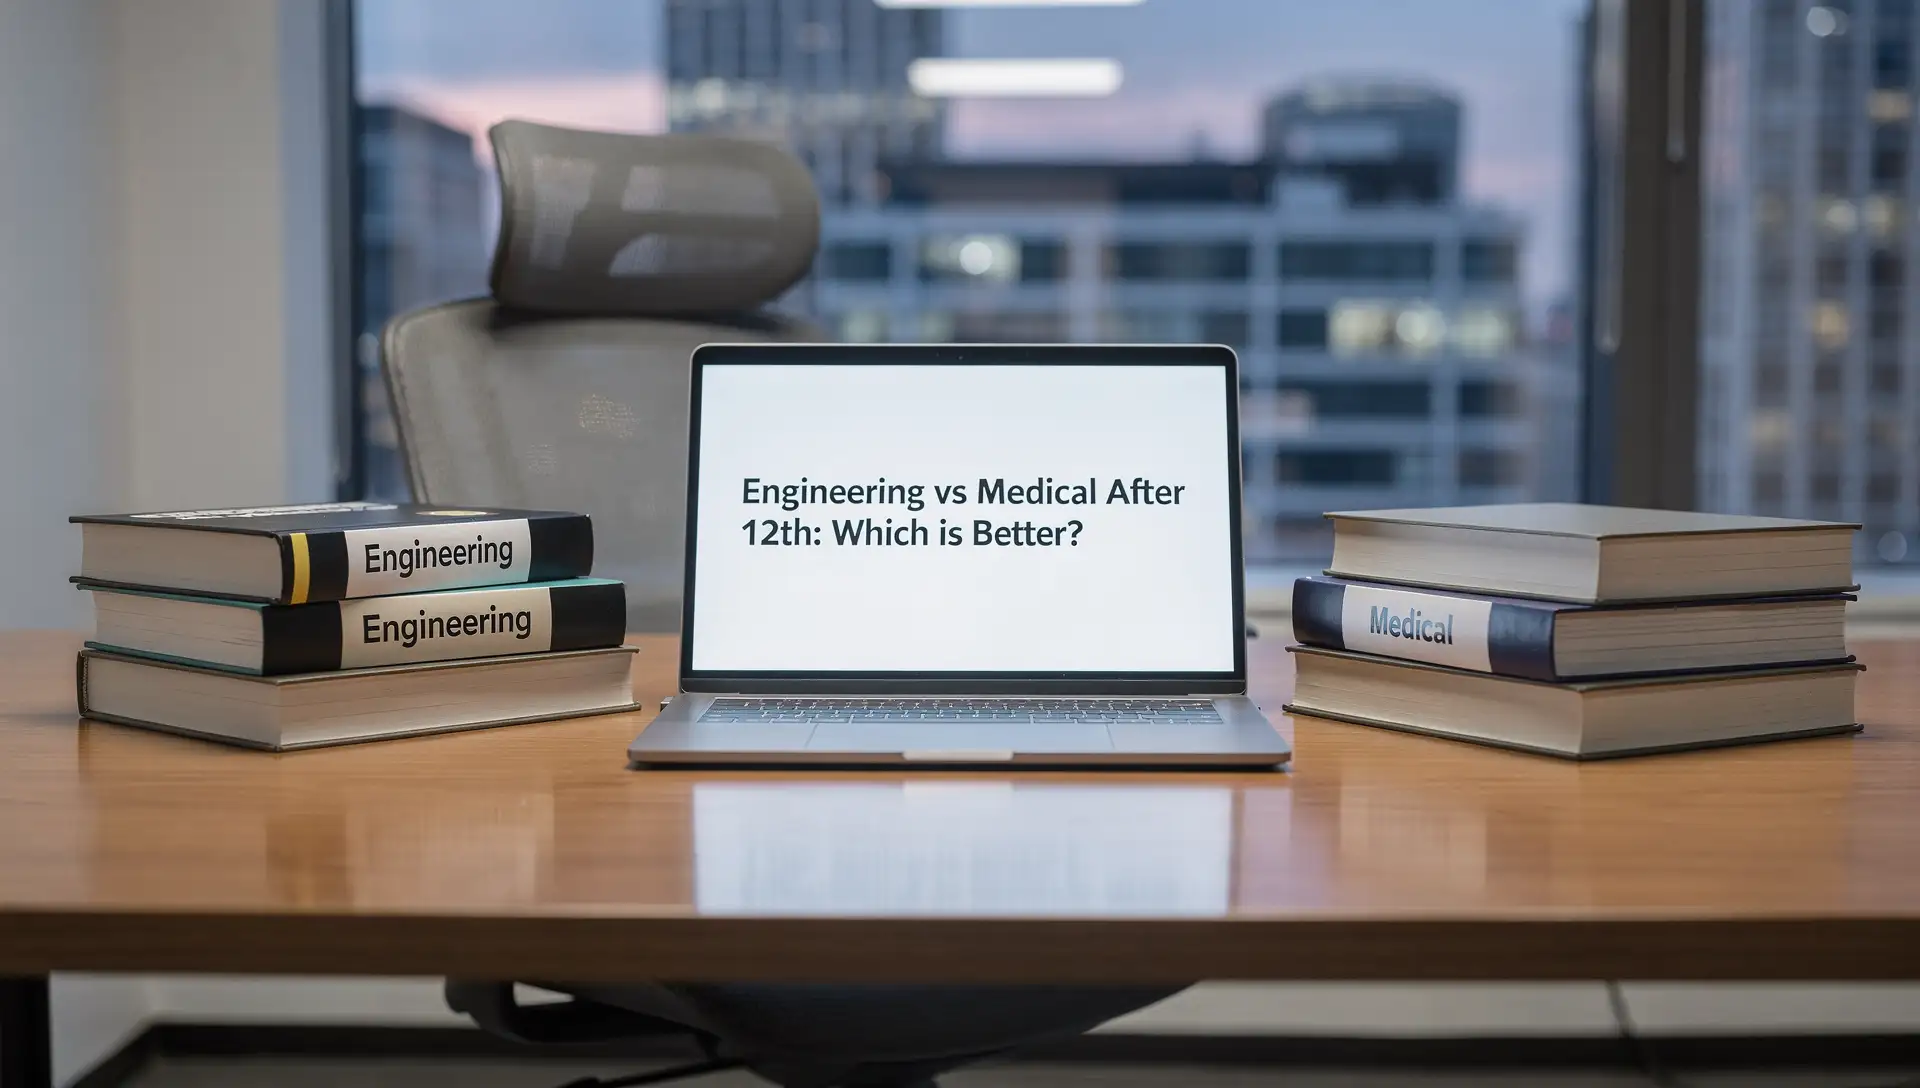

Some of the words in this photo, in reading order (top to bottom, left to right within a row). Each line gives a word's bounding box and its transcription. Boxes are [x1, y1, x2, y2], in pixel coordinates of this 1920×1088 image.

[743, 476, 925, 512] Engineering
[934, 484, 967, 505] vs
[977, 477, 1096, 505] Medical
[1106, 477, 1186, 505] After
[741, 518, 822, 546] 12th:
[832, 518, 928, 546] Which
[939, 518, 963, 546] is
[973, 519, 1084, 546] Better?
[364, 534, 513, 578] Engineering
[363, 604, 532, 647] Engineering
[1370, 605, 1454, 645] Medical
